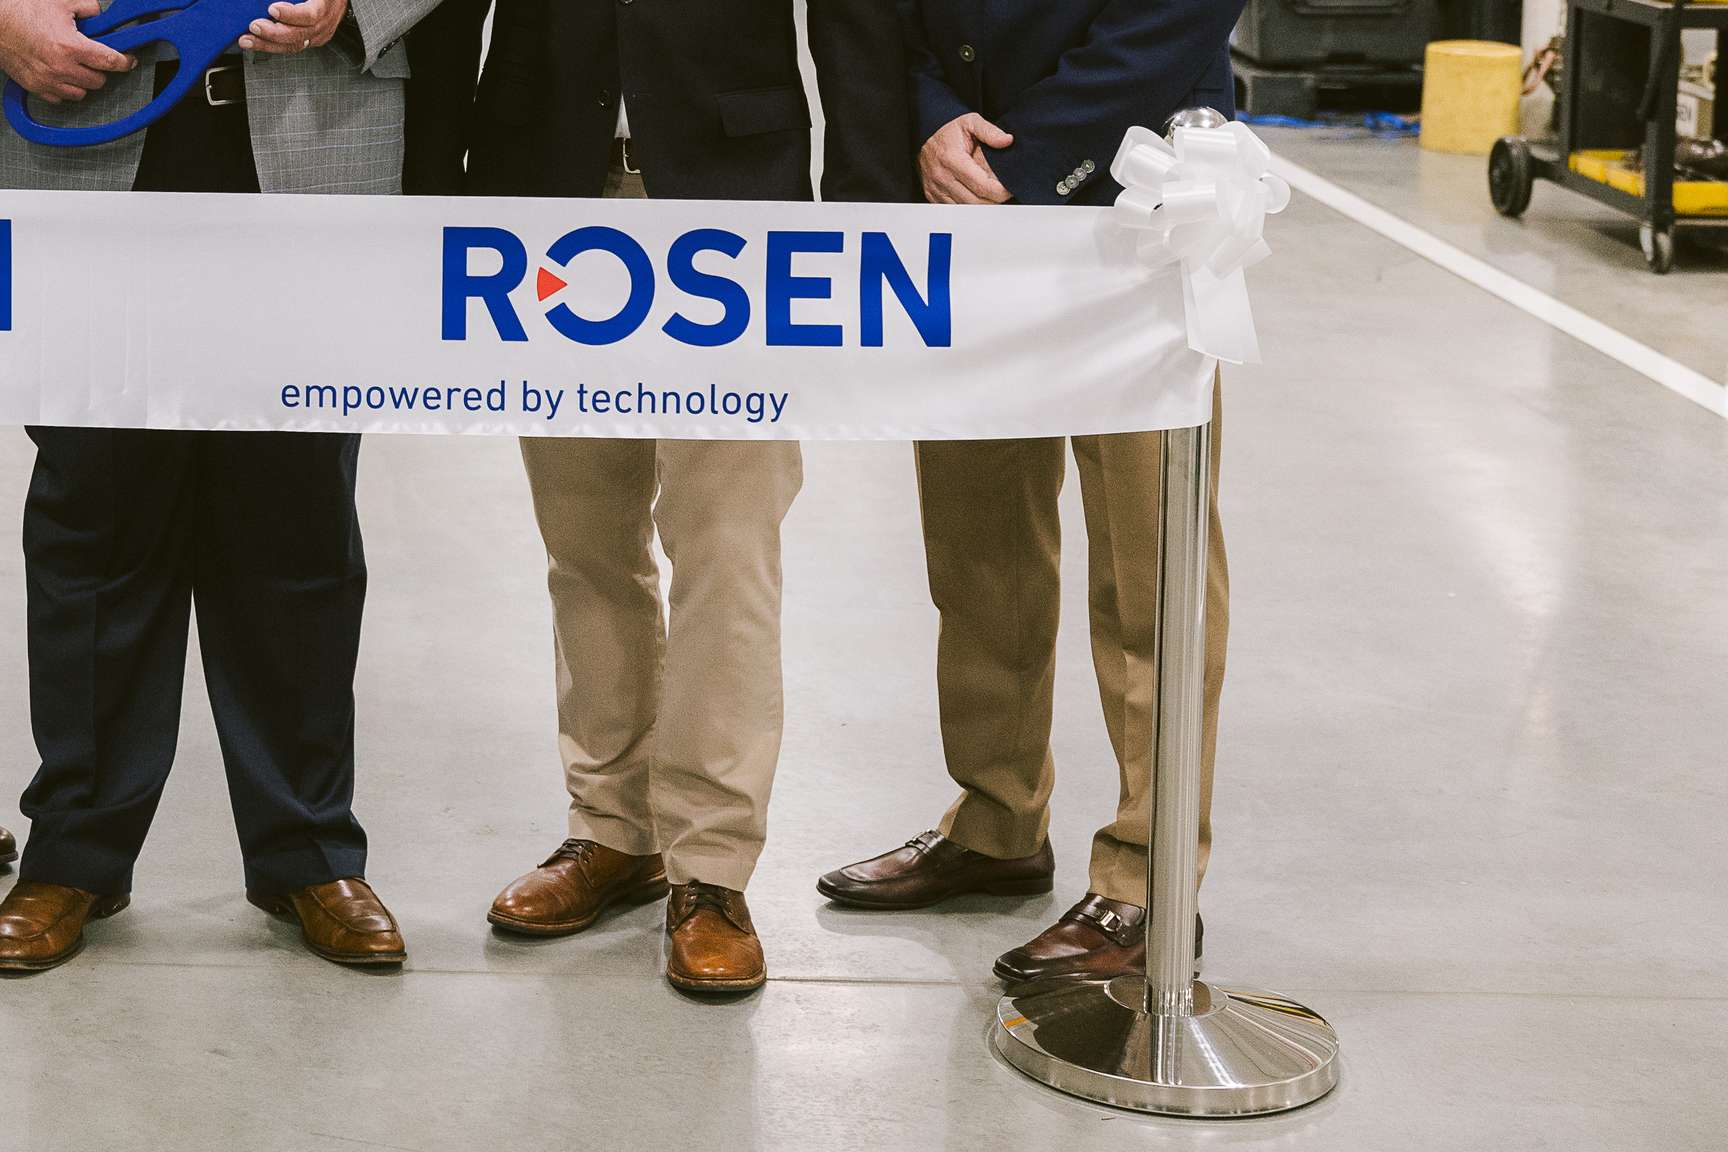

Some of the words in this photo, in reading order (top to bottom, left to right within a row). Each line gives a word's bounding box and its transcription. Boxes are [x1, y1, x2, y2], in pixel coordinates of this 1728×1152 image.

[441, 225, 953, 348] ROSEN
[280, 380, 506, 417] empowered
[522, 381, 564, 420] by
[576, 382, 789, 424] technology
